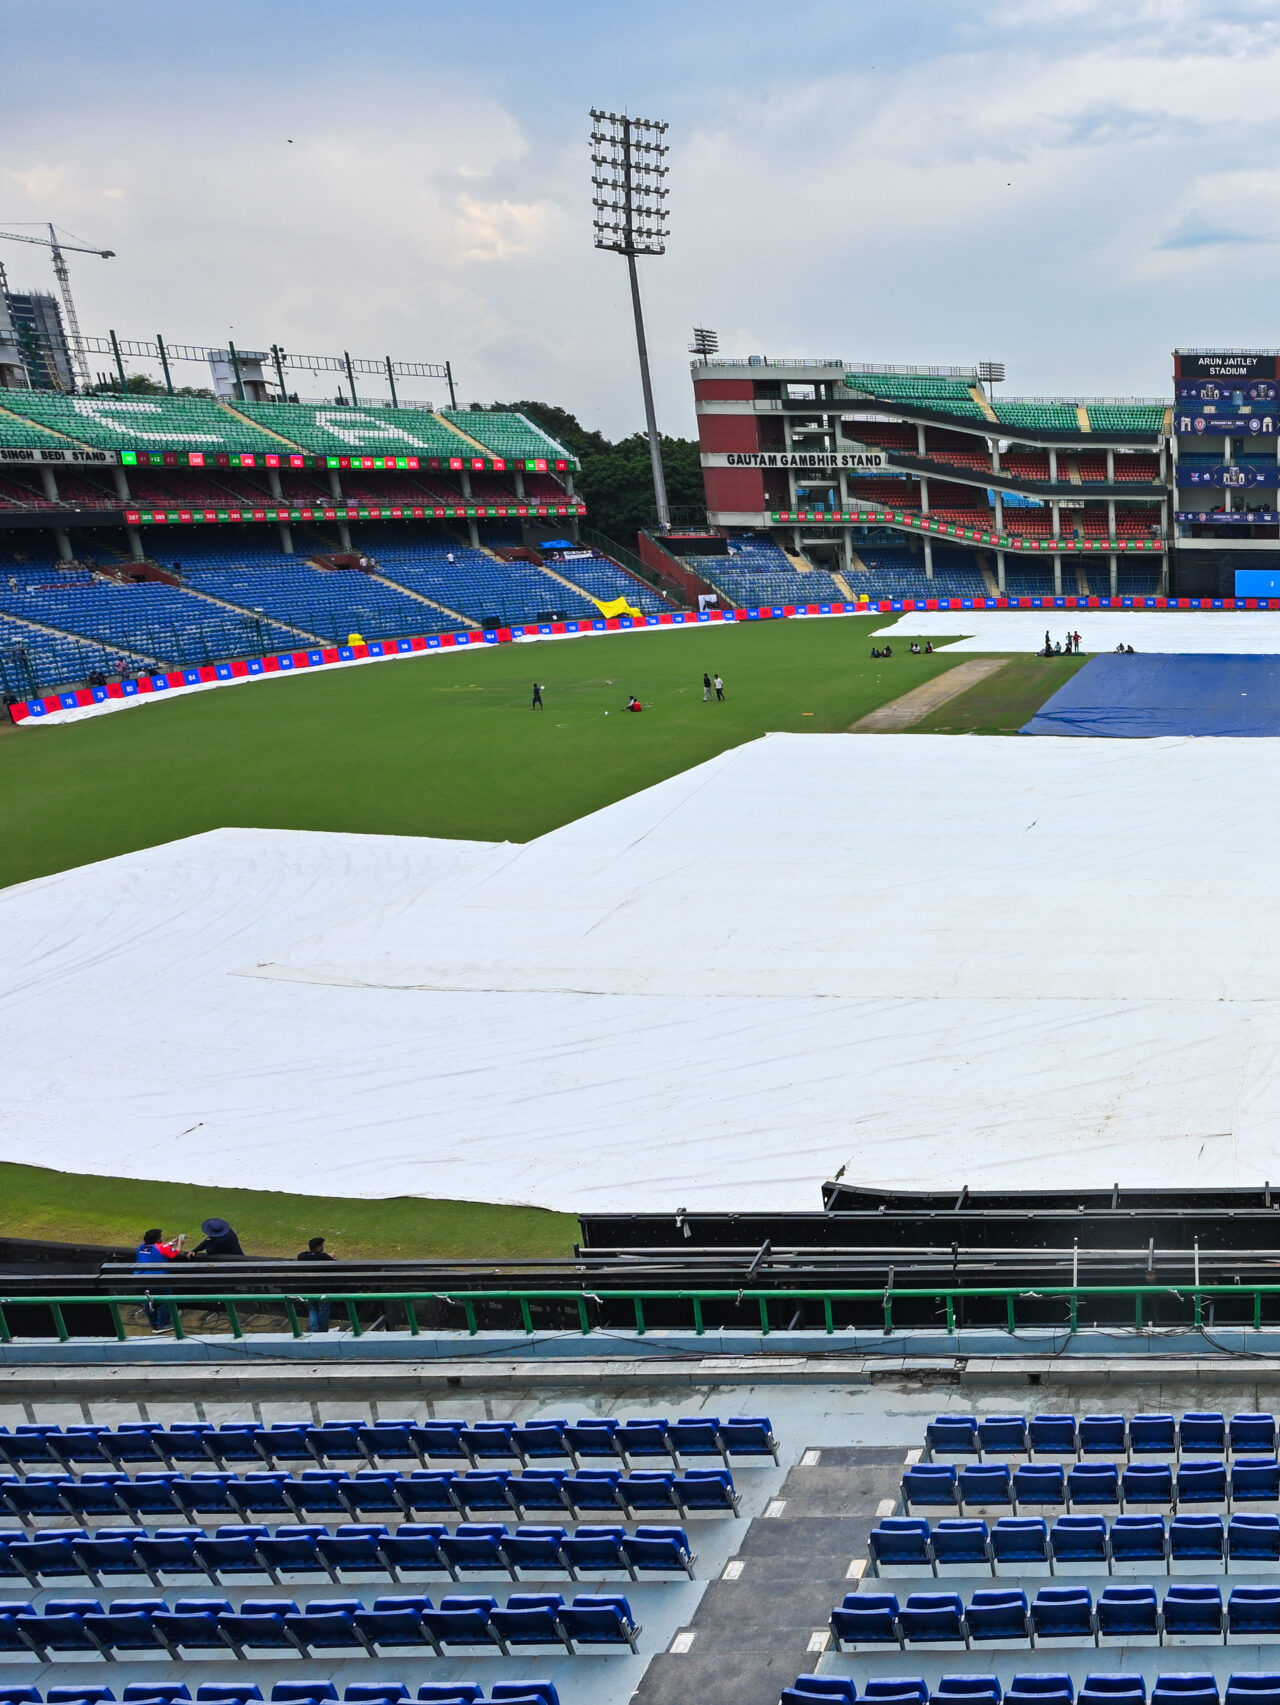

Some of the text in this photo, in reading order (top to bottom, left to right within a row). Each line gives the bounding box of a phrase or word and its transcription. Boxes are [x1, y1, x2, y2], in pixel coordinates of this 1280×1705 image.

[0, 450, 106, 461] SINGH BEDI STAND
[727, 454, 881, 466] GAUTAM GAMBHIR STAND
